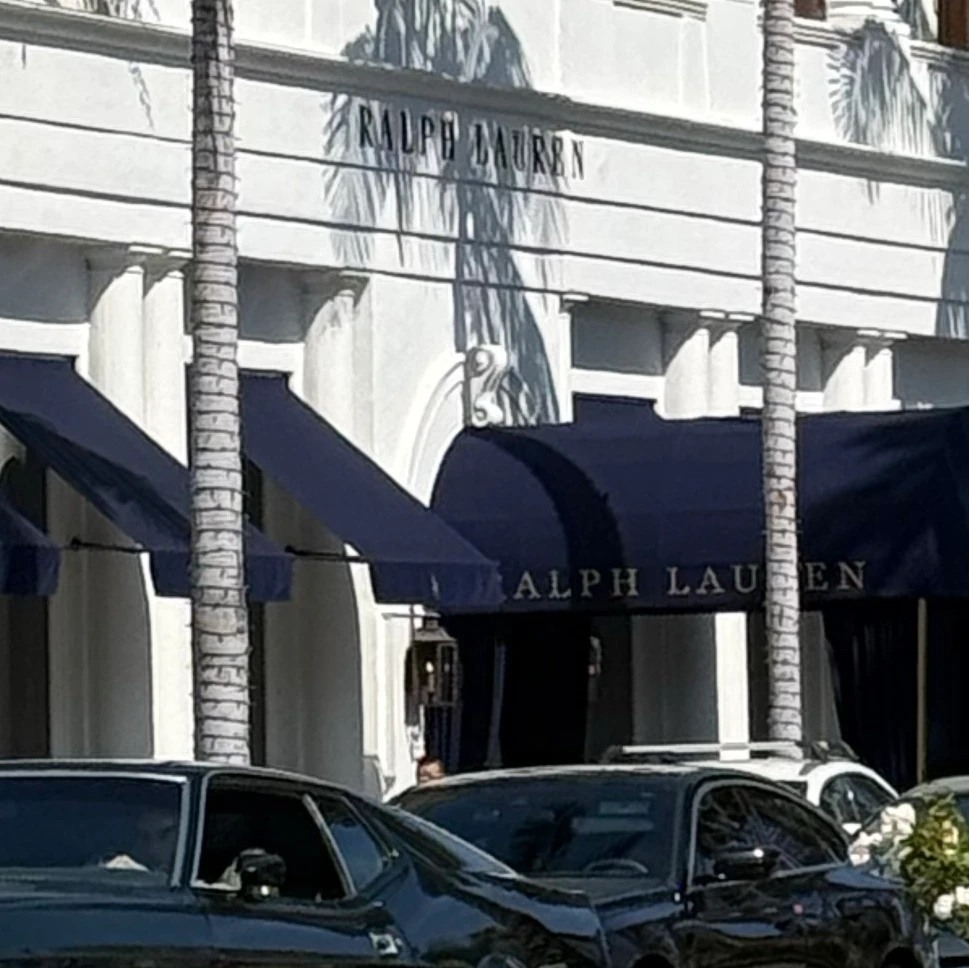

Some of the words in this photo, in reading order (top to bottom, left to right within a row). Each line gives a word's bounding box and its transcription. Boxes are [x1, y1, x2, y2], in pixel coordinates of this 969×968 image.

[359, 106, 455, 161] RALPH
[476, 123, 584, 180] LAUREN
[498, 569, 639, 599] ALPH
[668, 561, 867, 595] LAUEN
